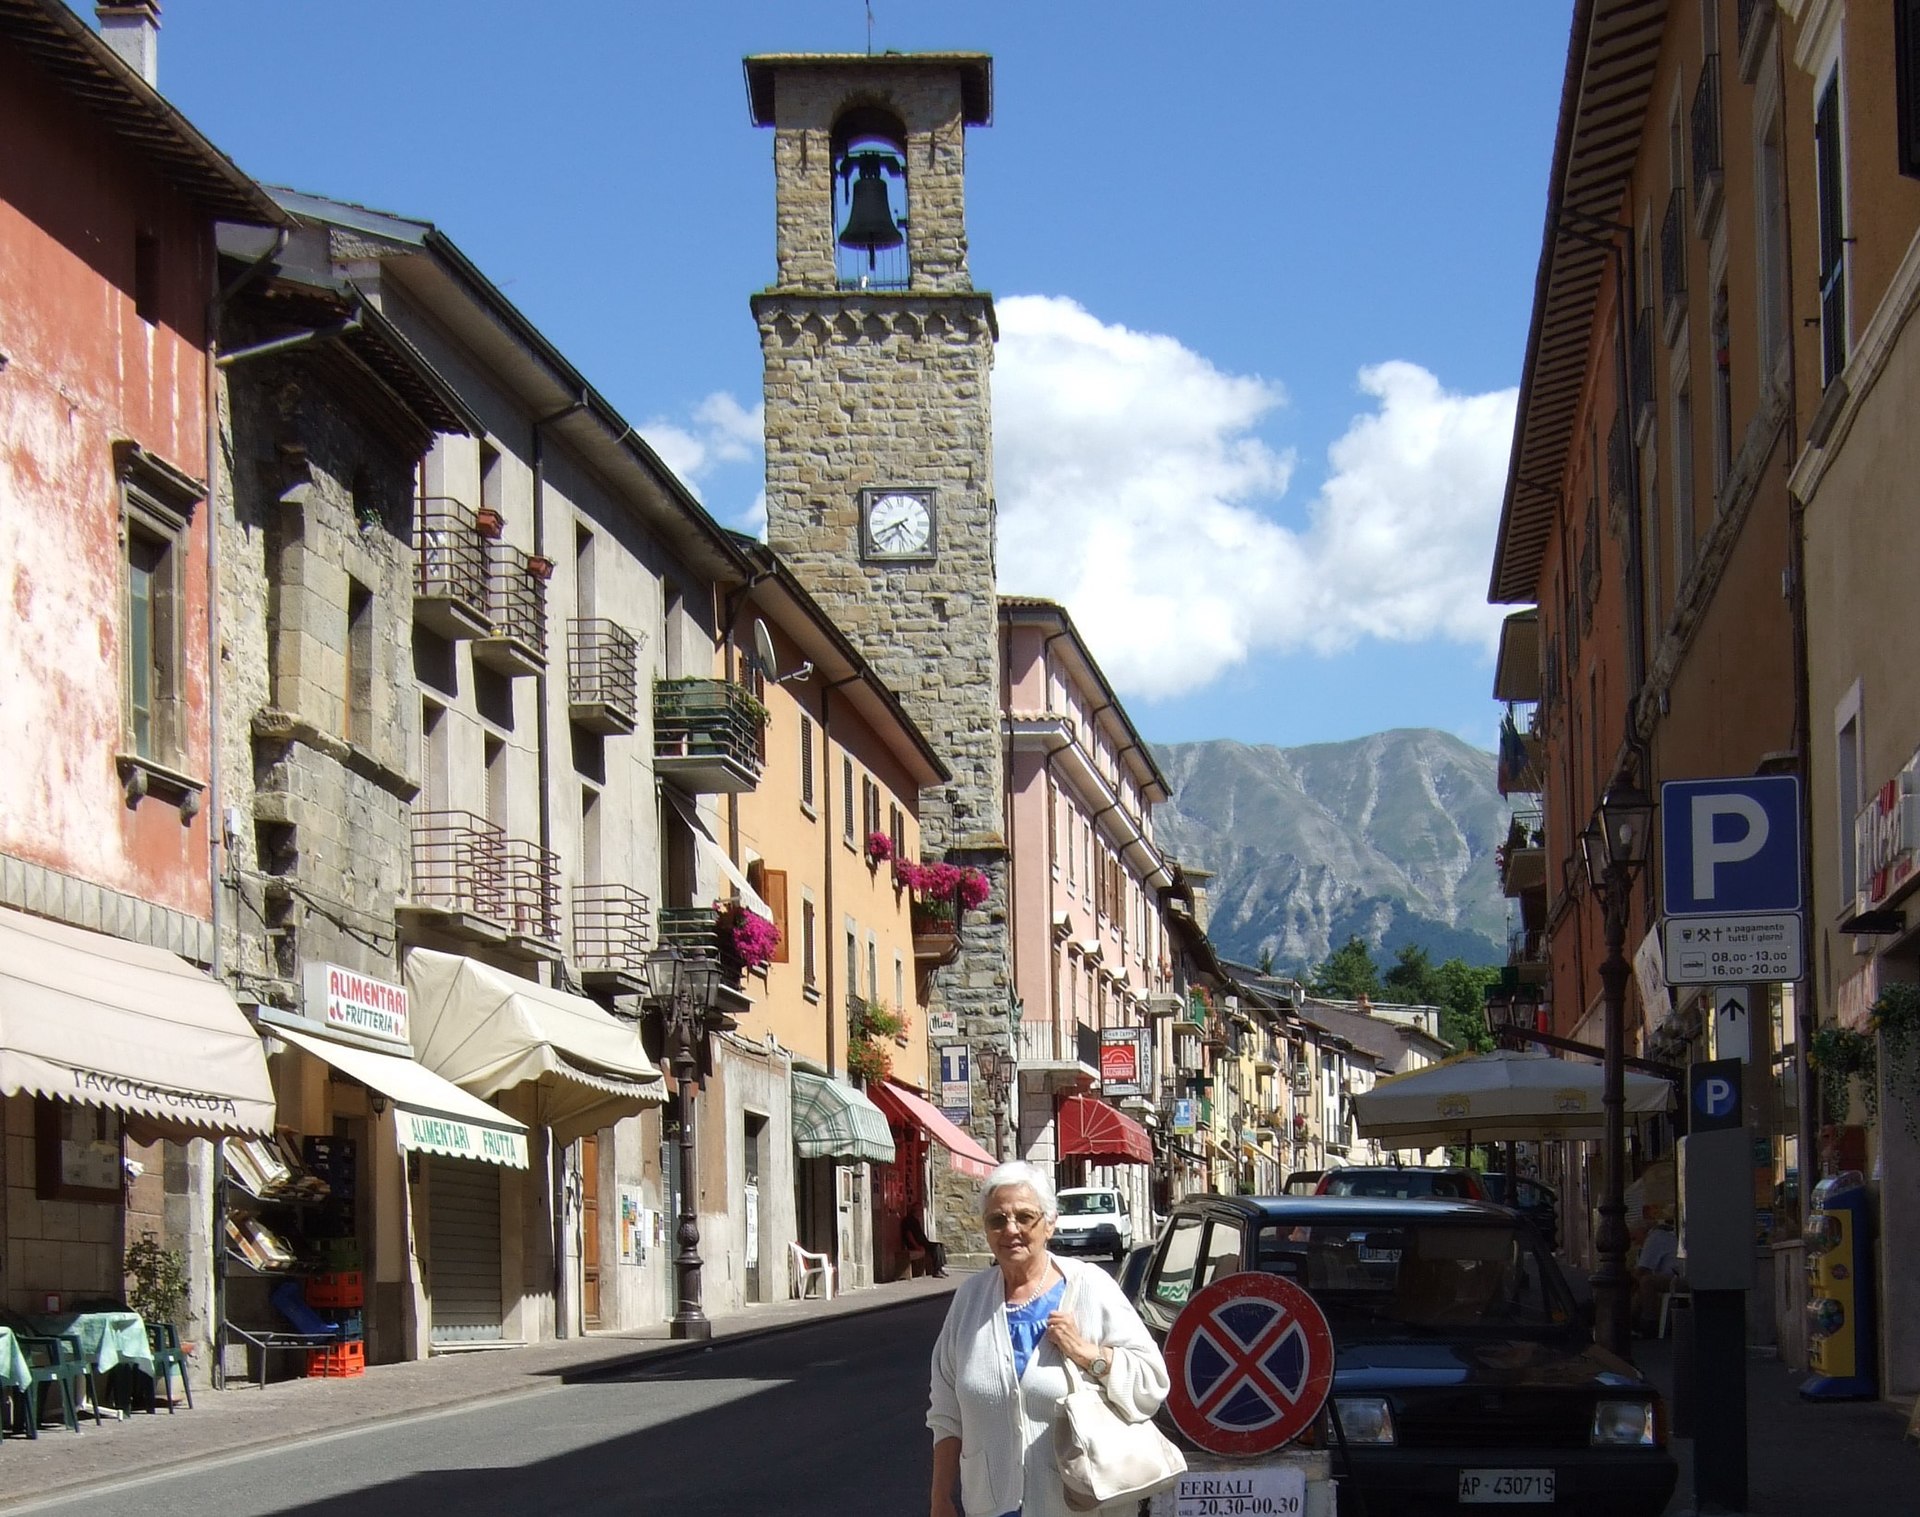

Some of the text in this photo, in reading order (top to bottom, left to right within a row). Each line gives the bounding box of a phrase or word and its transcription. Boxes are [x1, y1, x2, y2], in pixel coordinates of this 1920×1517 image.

[1691, 793, 1770, 900] P
[1728, 933, 1748, 942] tutti
[1757, 932, 1783, 942] giorni
[1734, 923, 1785, 933] pagamento
[331, 971, 407, 1018] ALIMENTARI
[345, 1004, 393, 1033] FRUTTERIA
[942, 1046, 967, 1081] T
[70, 1068, 237, 1118] TAVOLA CALDA
[1707, 1080, 1729, 1114] P
[411, 1117, 516, 1160] ALIMENTARI FRUTTA
[1180, 1480, 1253, 1496] FERIALI
[1198, 1497, 1299, 1517] 20,30-00,30
